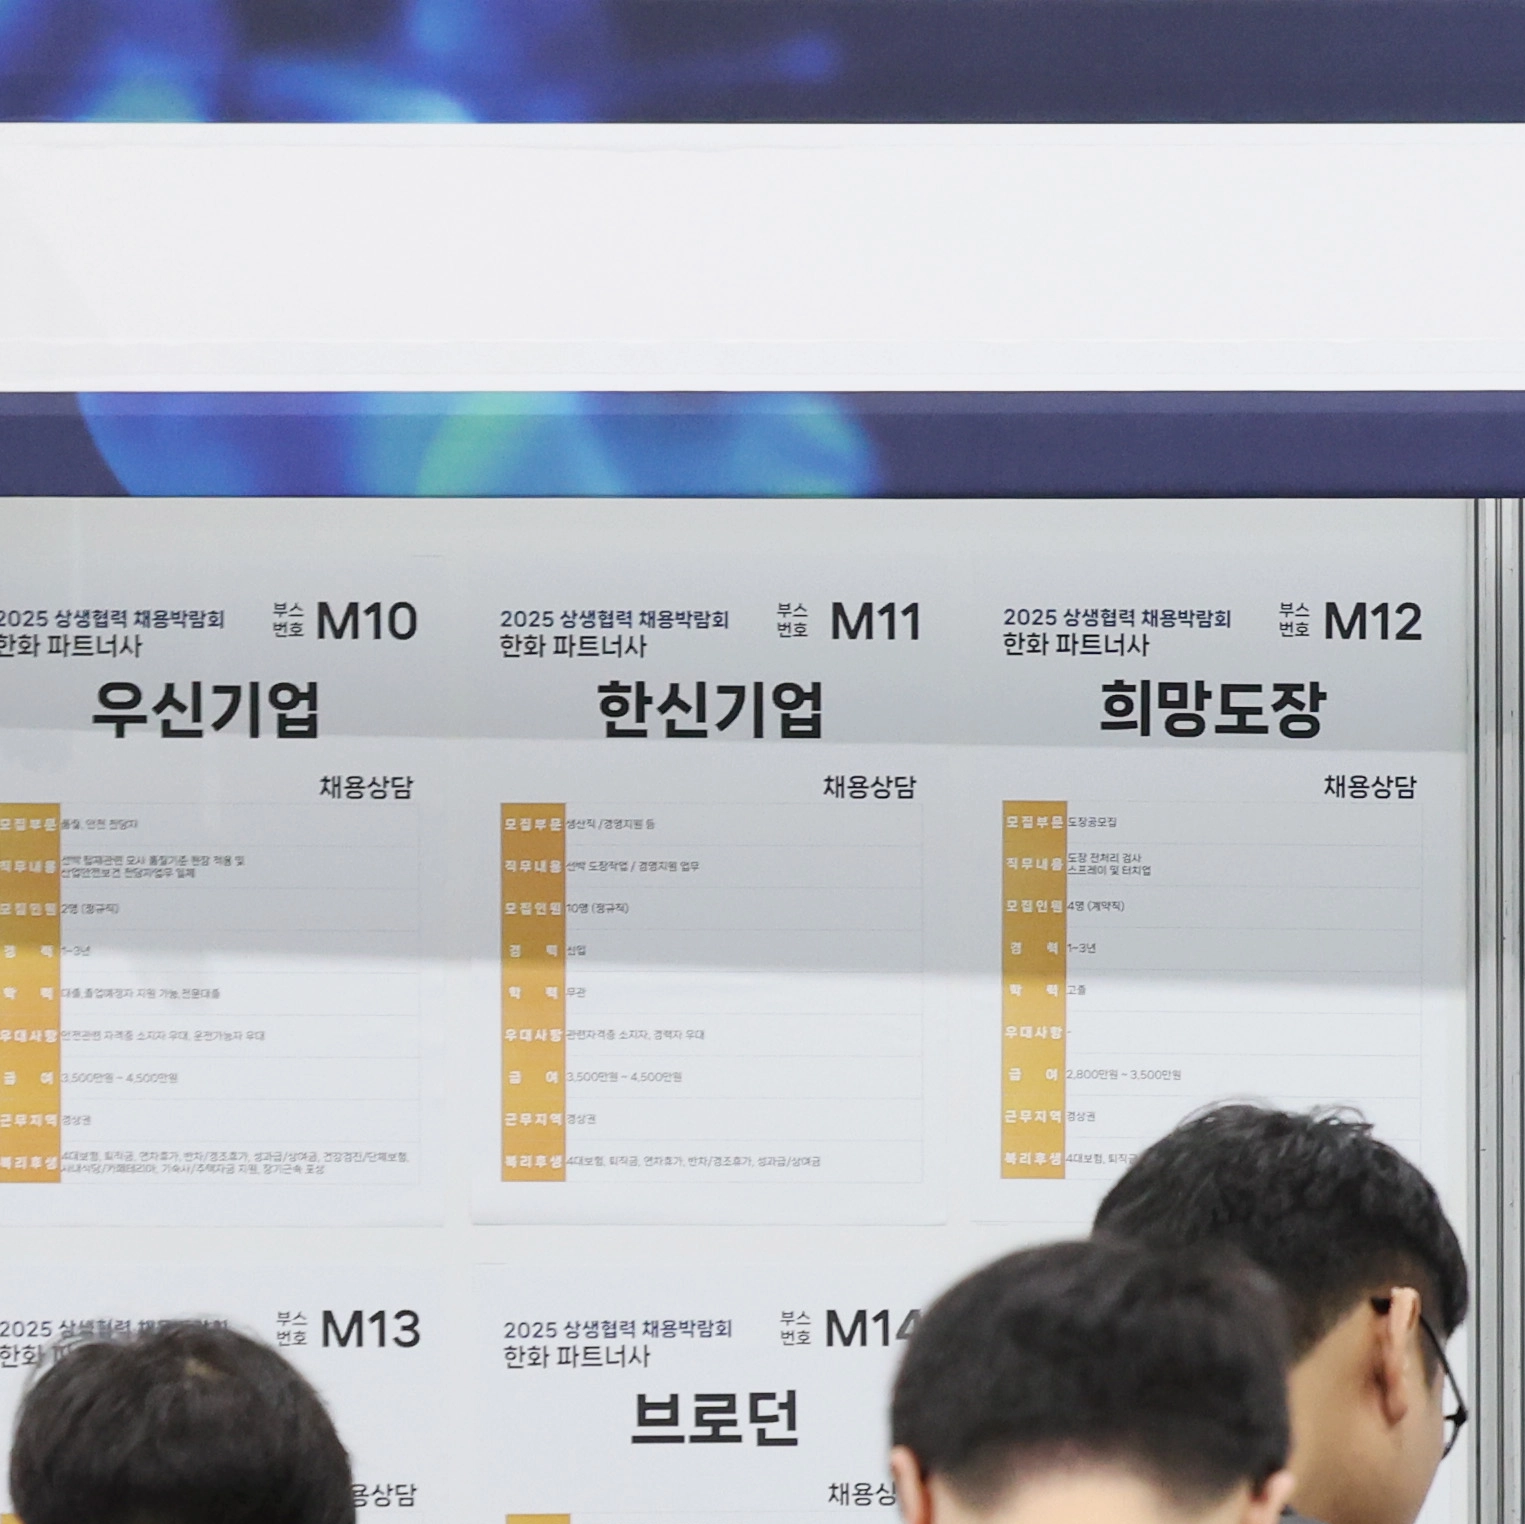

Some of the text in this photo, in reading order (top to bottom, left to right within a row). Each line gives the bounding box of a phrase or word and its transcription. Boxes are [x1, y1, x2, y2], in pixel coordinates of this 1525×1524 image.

[0, 609, 224, 629] 2025 상생협력 채용박람회
[272, 602, 305, 618] 부스
[316, 601, 418, 641] M10
[500, 609, 729, 630] 2025 상생협력 채용박람회
[776, 602, 809, 618] 부스
[831, 601, 920, 641] M11
[1003, 608, 1231, 629] 2025 상생협력 채용박람회
[1279, 602, 1310, 618] 부스
[1324, 601, 1423, 641] M12
[273, 621, 305, 638] 번호
[777, 622, 809, 639] 번호
[1279, 621, 1310, 638] 번호
[47, 633, 143, 659] 파트너사
[499, 633, 648, 659] 한화 파트너사
[1002, 631, 1151, 657] 한화 파트너사
[92, 680, 318, 739] 우신기업
[597, 680, 822, 739] 한신기업
[1100, 679, 1328, 739] 희망도장
[319, 775, 414, 800] 채용상담
[823, 775, 917, 800] 채용상담
[1324, 774, 1418, 800] 채용상담
[276, 1311, 308, 1327] 부스
[322, 1309, 421, 1348] M13
[504, 1319, 732, 1340] 2025 상생협력 채용박람회
[780, 1310, 812, 1326] 부스
[276, 1330, 308, 1348] 번호
[780, 1330, 811, 1346] 번호
[503, 1344, 651, 1369] 한화 파트너사
[631, 1389, 799, 1447] 브로던
[350, 1483, 418, 1508] 용상담
[828, 1481, 898, 1507] 채용상
